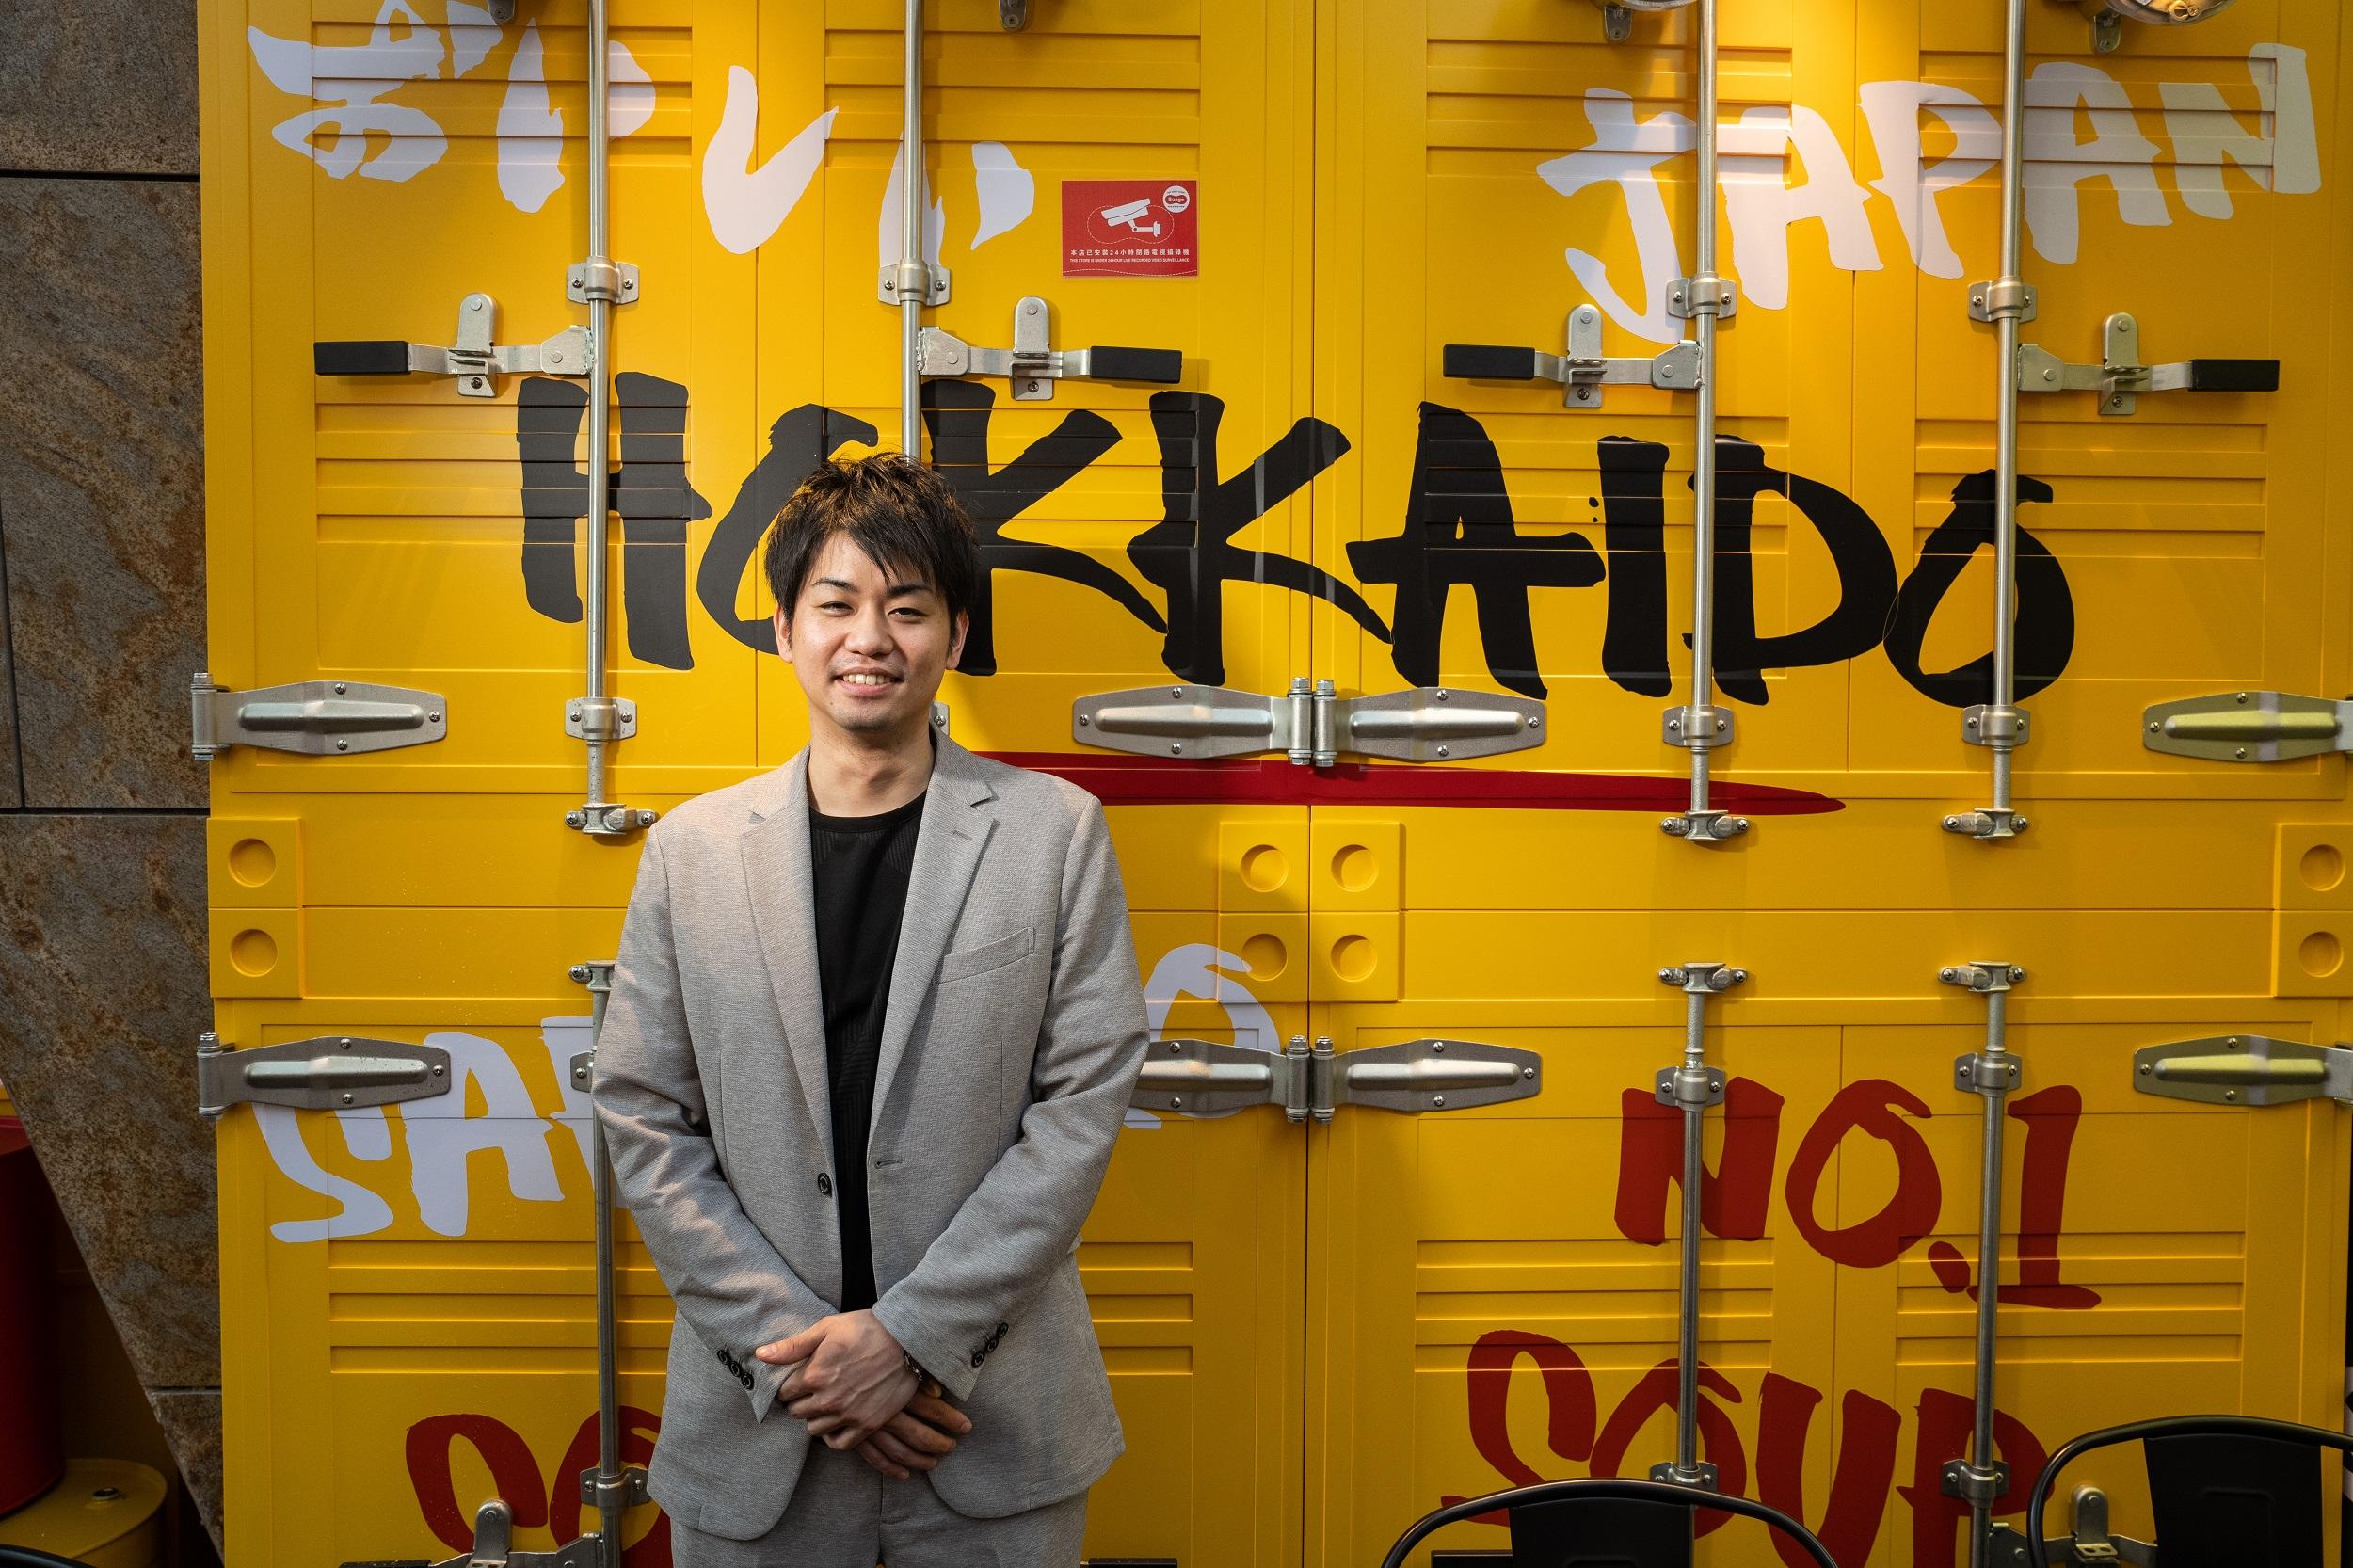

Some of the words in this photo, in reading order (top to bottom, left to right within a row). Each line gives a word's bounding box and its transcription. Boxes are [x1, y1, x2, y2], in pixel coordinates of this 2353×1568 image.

[247, 0, 1036, 271] おいしい
[1536, 42, 2322, 344] JAPAN
[516, 371, 2074, 708] HOKKAIDO
[1614, 1076, 2102, 1309] NO.1
[1441, 1329, 2056, 1568] SOUP
